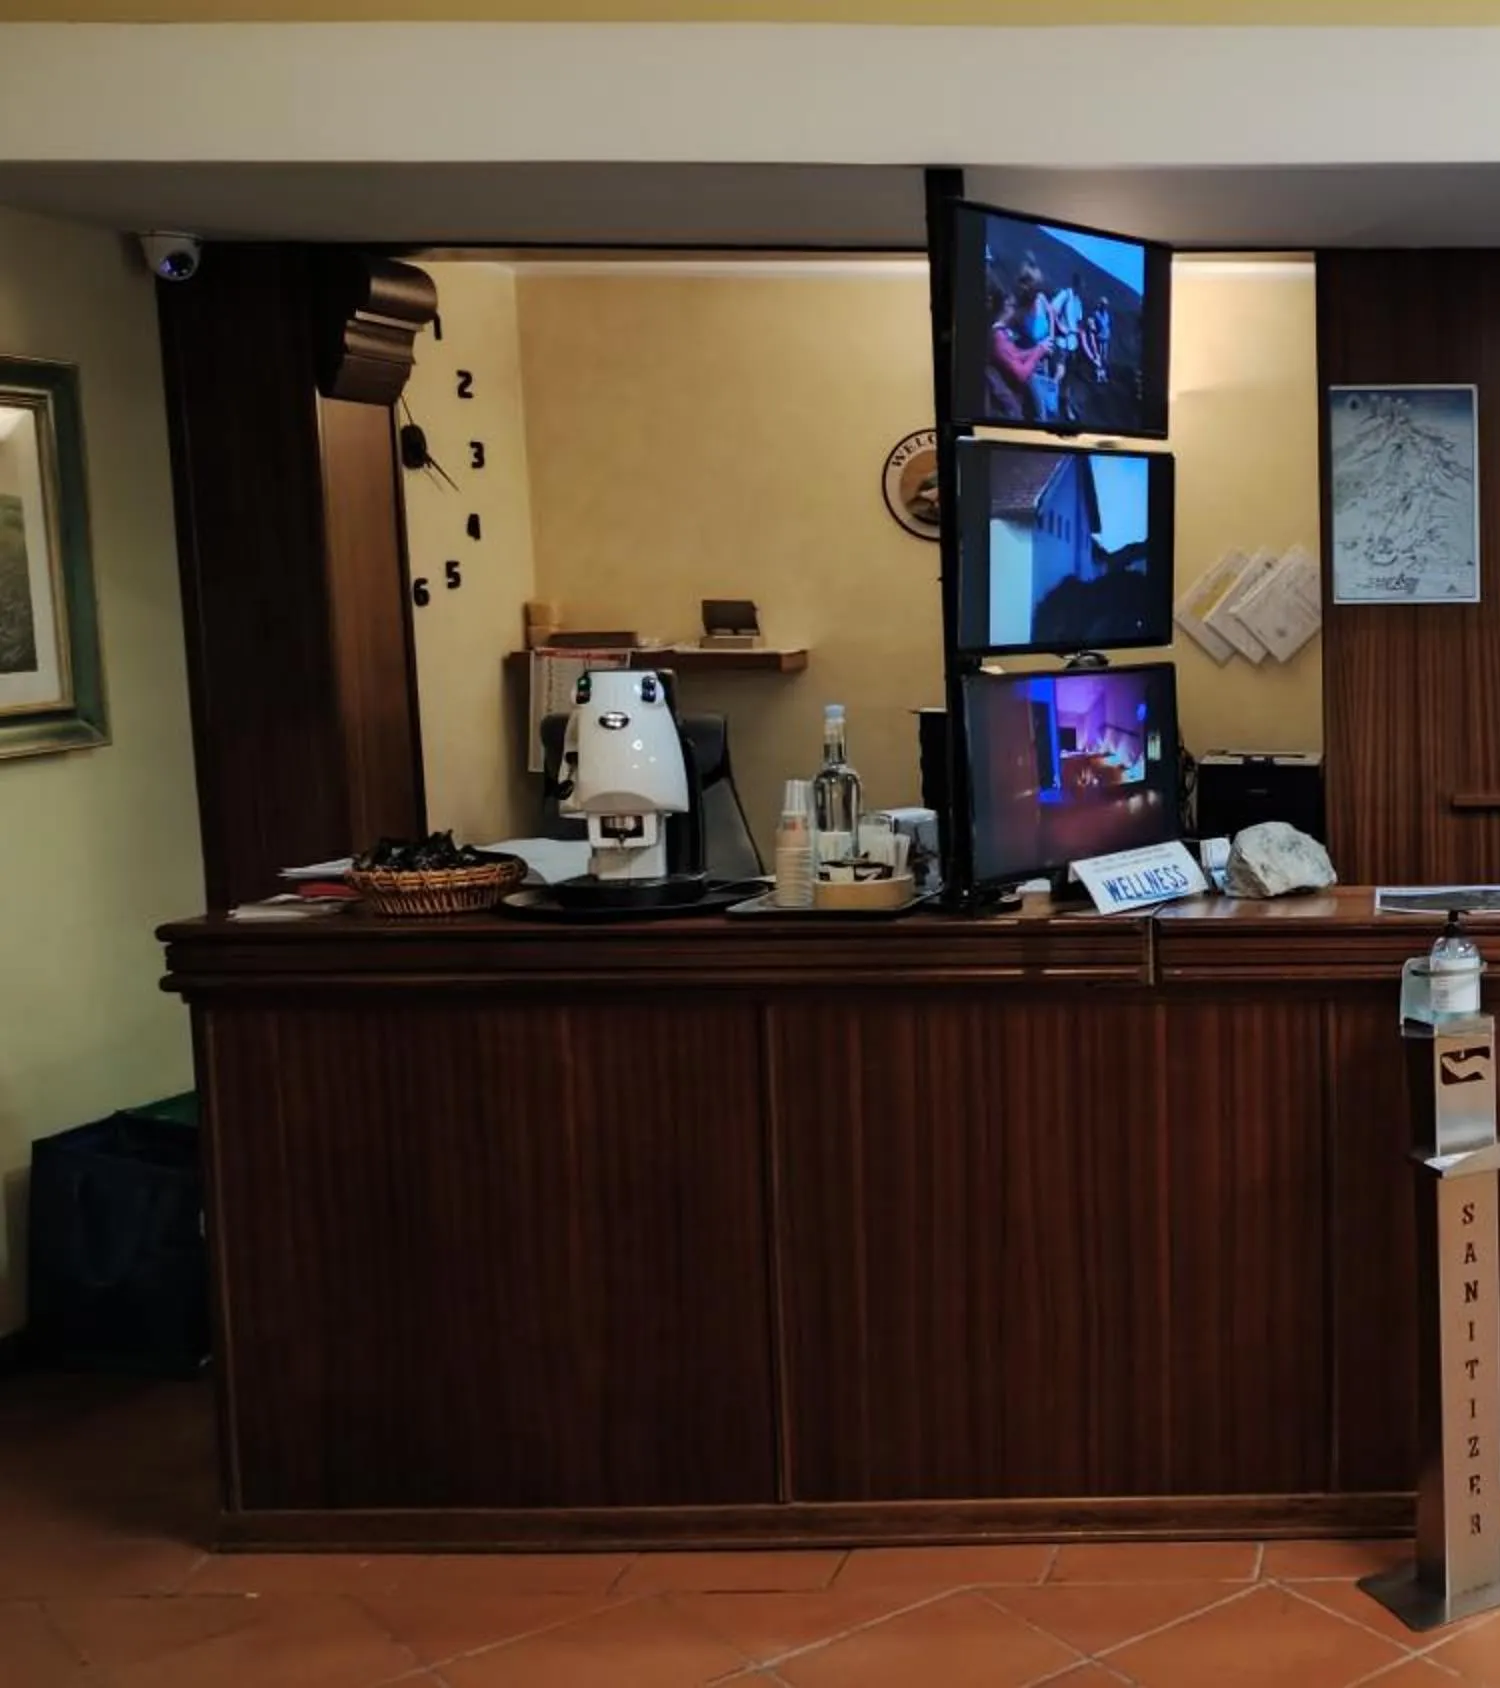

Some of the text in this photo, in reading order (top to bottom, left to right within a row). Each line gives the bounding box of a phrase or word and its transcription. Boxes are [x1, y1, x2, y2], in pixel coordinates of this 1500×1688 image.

[456, 370, 473, 399] 2
[469, 441, 485, 468] 3
[466, 513, 481, 541] 4
[445, 560, 461, 589] 5
[413, 577, 430, 607] 6
[1102, 864, 1189, 903] WELLNESS
[1461, 1203, 1481, 1535] SANITIZER
